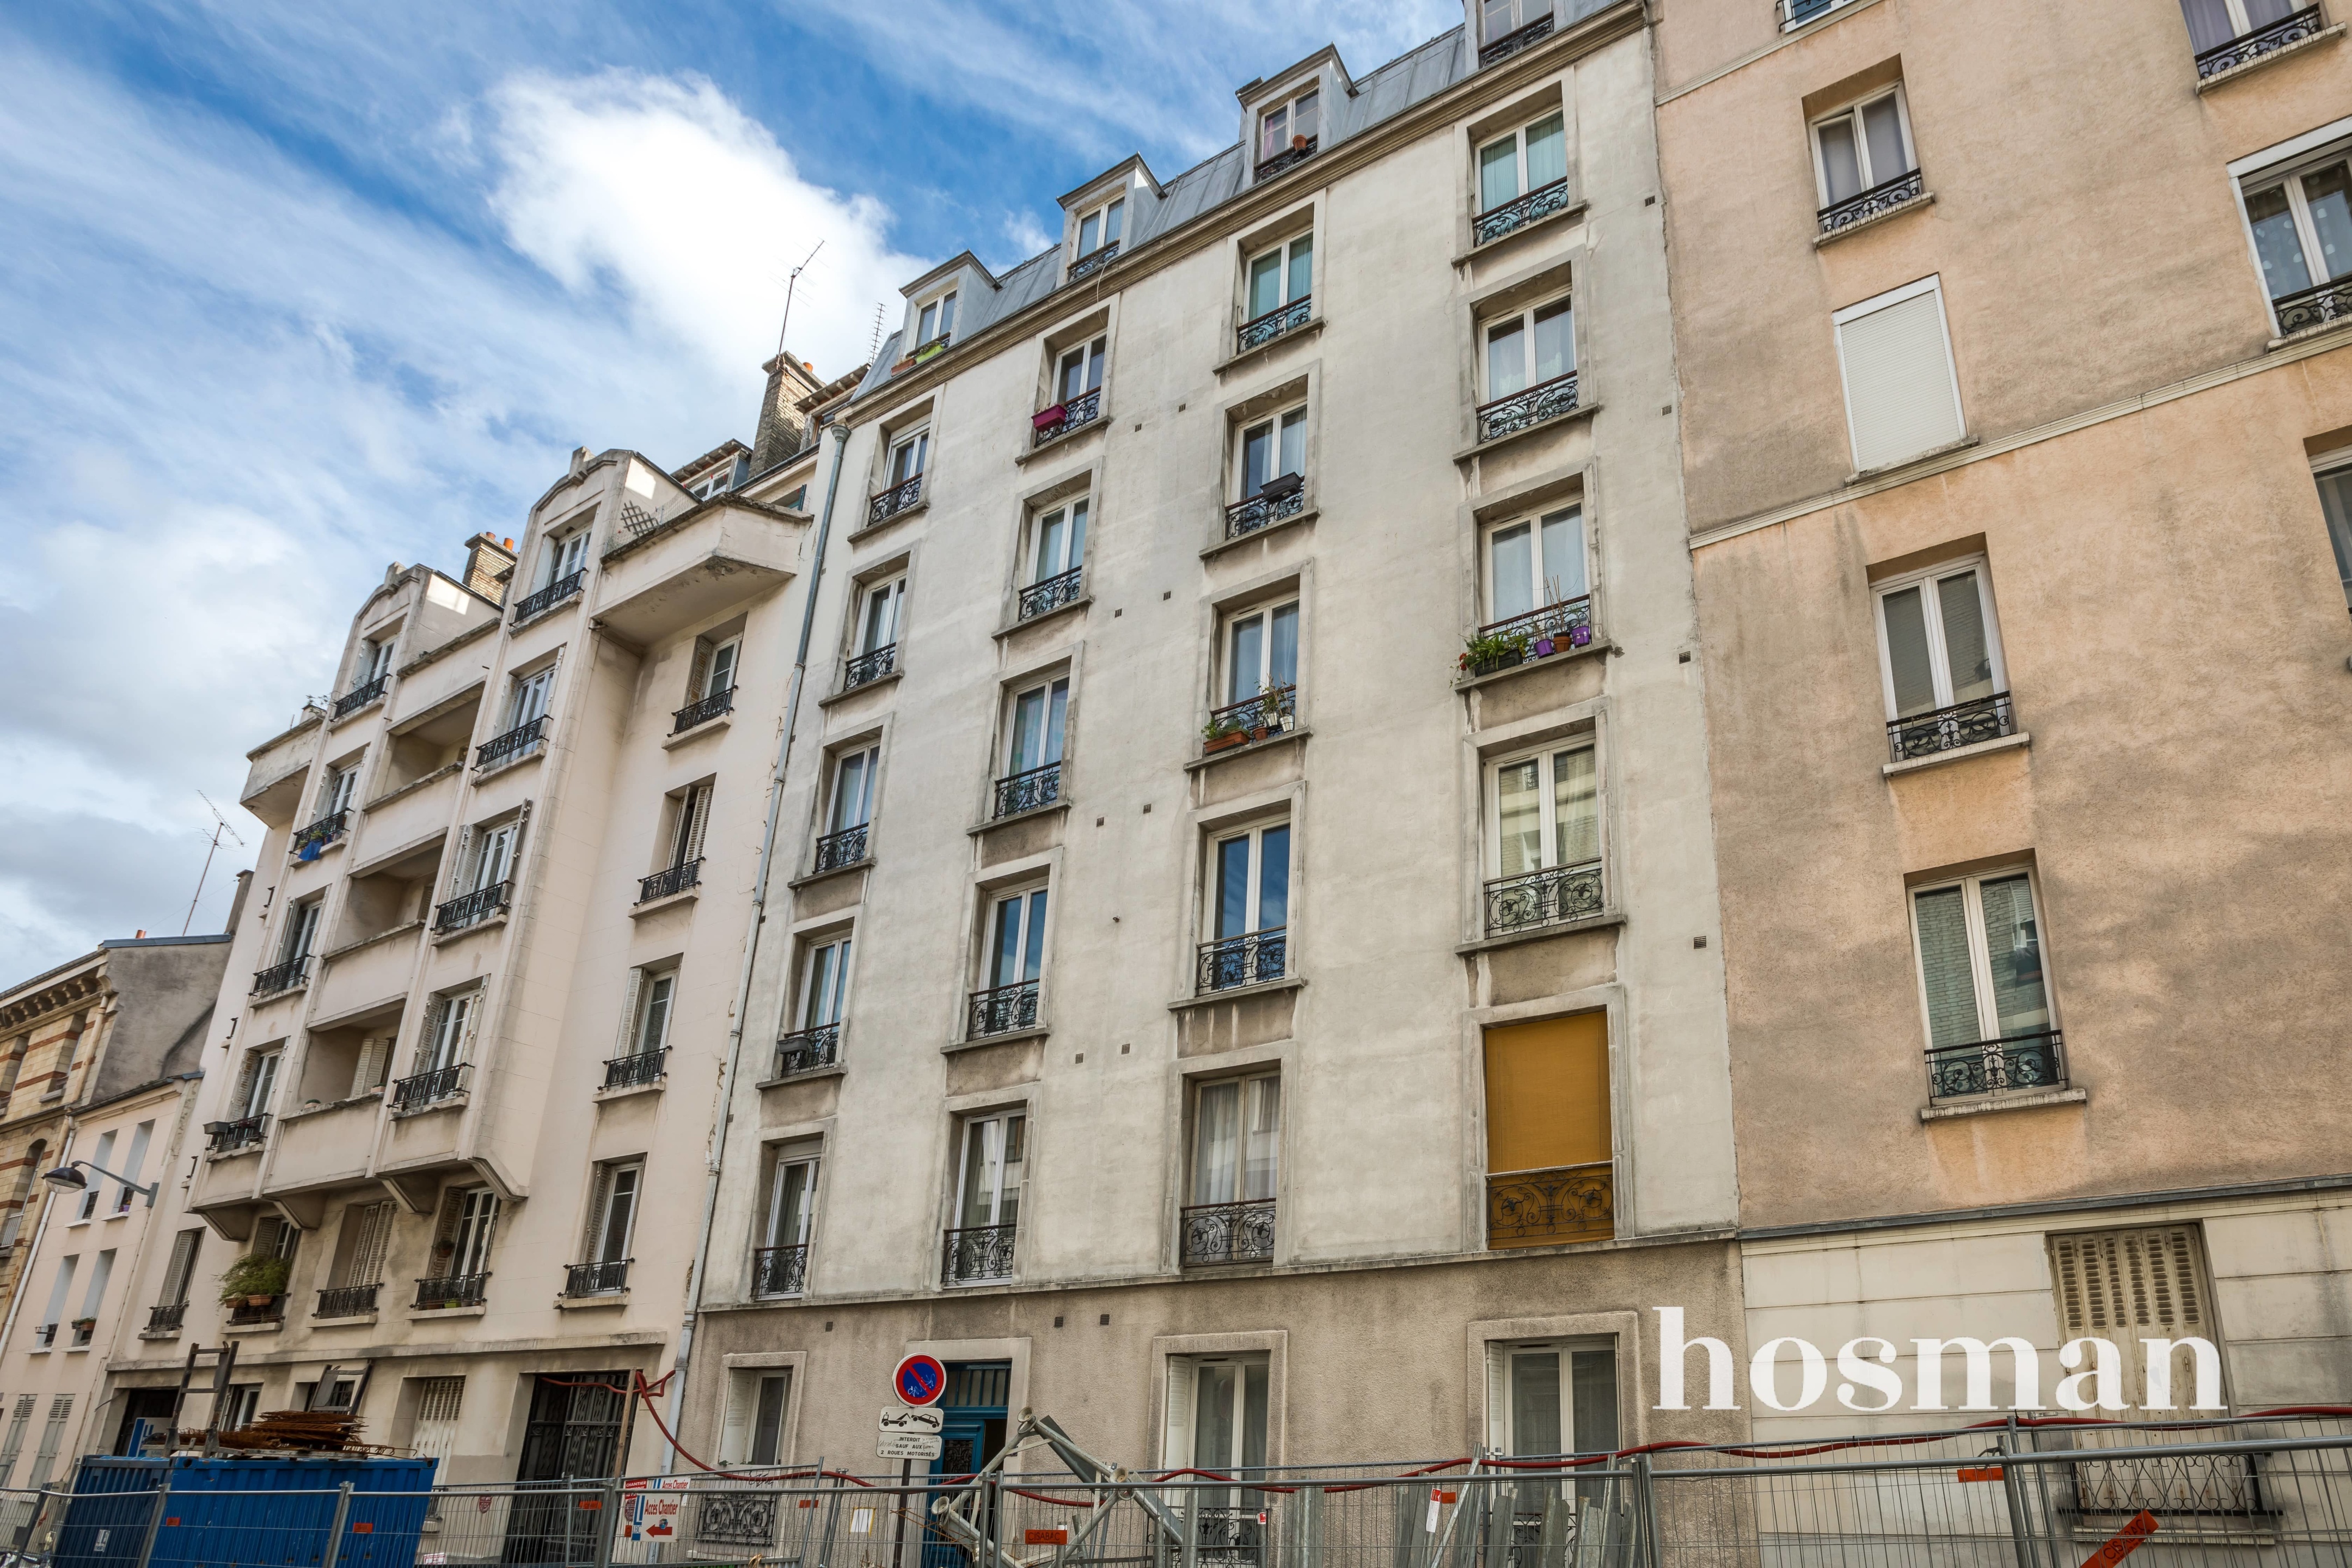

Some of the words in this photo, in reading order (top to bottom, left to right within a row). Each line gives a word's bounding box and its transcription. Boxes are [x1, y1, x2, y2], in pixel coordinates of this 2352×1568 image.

[662, 1480, 672, 1489] Accès
[672, 1479, 689, 1489] Chantier
[644, 1499, 658, 1515] Accès
[658, 1499, 678, 1515] Chantier
[633, 1525, 642, 1533] LBC
[1028, 1532, 1061, 1541] CISABAC
